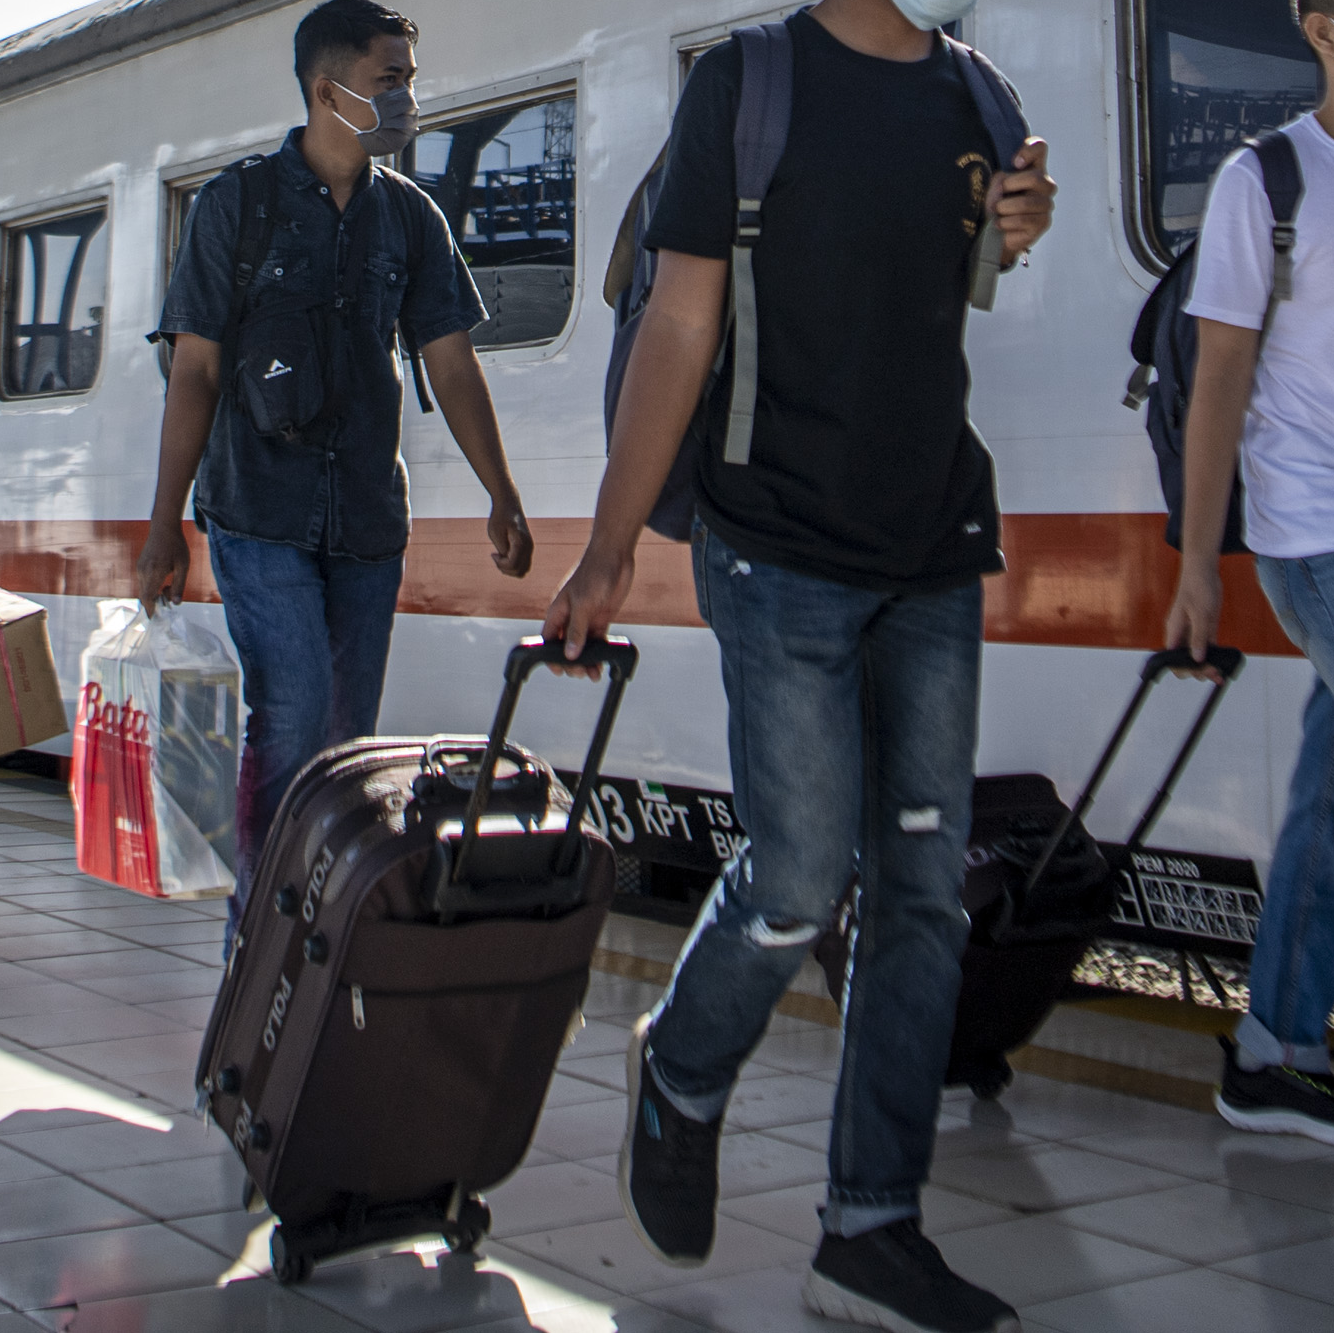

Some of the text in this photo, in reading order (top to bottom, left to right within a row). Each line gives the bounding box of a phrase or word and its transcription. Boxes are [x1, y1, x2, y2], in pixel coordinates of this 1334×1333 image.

[81, 681, 150, 743] Bata
[636, 798, 693, 842] KPT
[698, 795, 734, 829] TS
[302, 844, 334, 924] POLO
[1164, 856, 1201, 879] 2020
[263, 972, 293, 1052] POLO
[234, 1098, 253, 1153] POL
